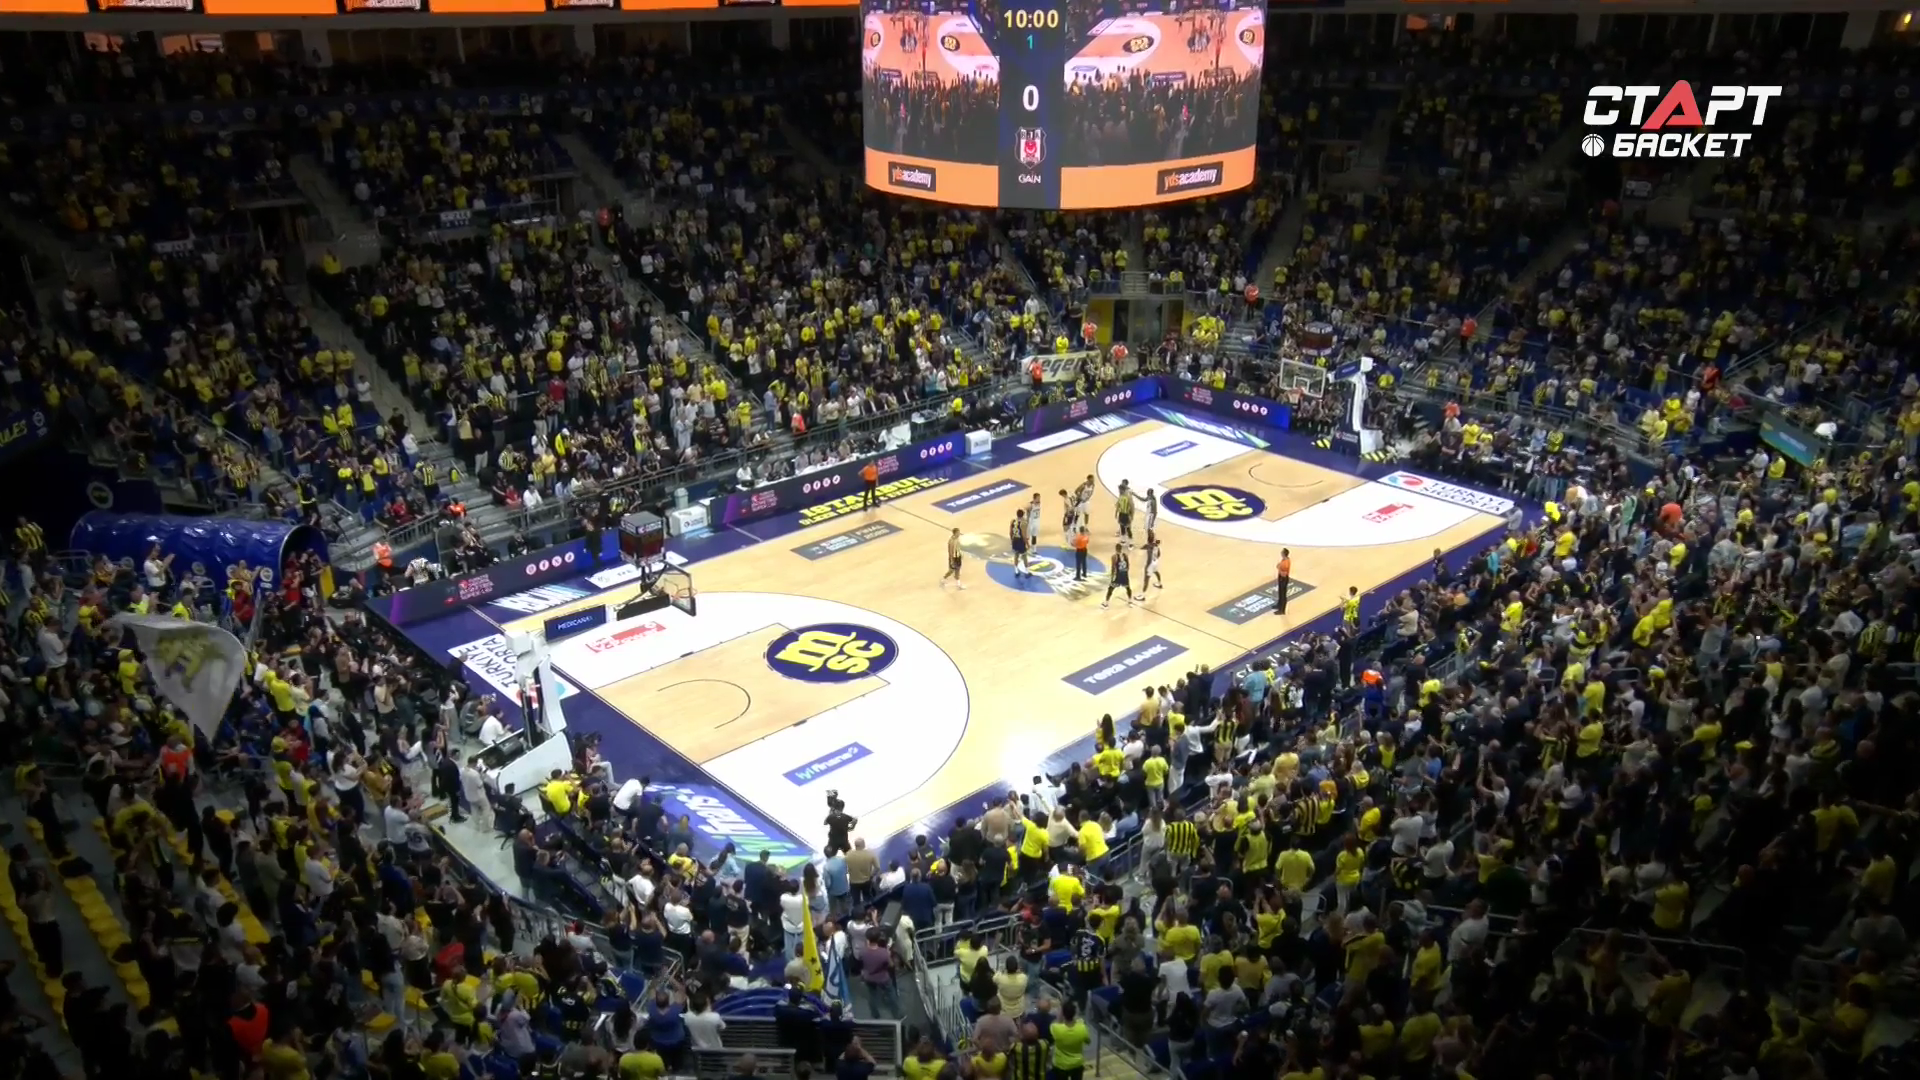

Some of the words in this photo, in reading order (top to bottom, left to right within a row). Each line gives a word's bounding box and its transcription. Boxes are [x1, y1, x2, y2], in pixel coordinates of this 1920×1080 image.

[1003, 9, 1059, 29] 10:00
[1026, 34, 1034, 50] 1
[1022, 85, 1039, 112] 0
[891, 167, 932, 188] ydsacademy
[1163, 167, 1218, 192] ydsacademy
